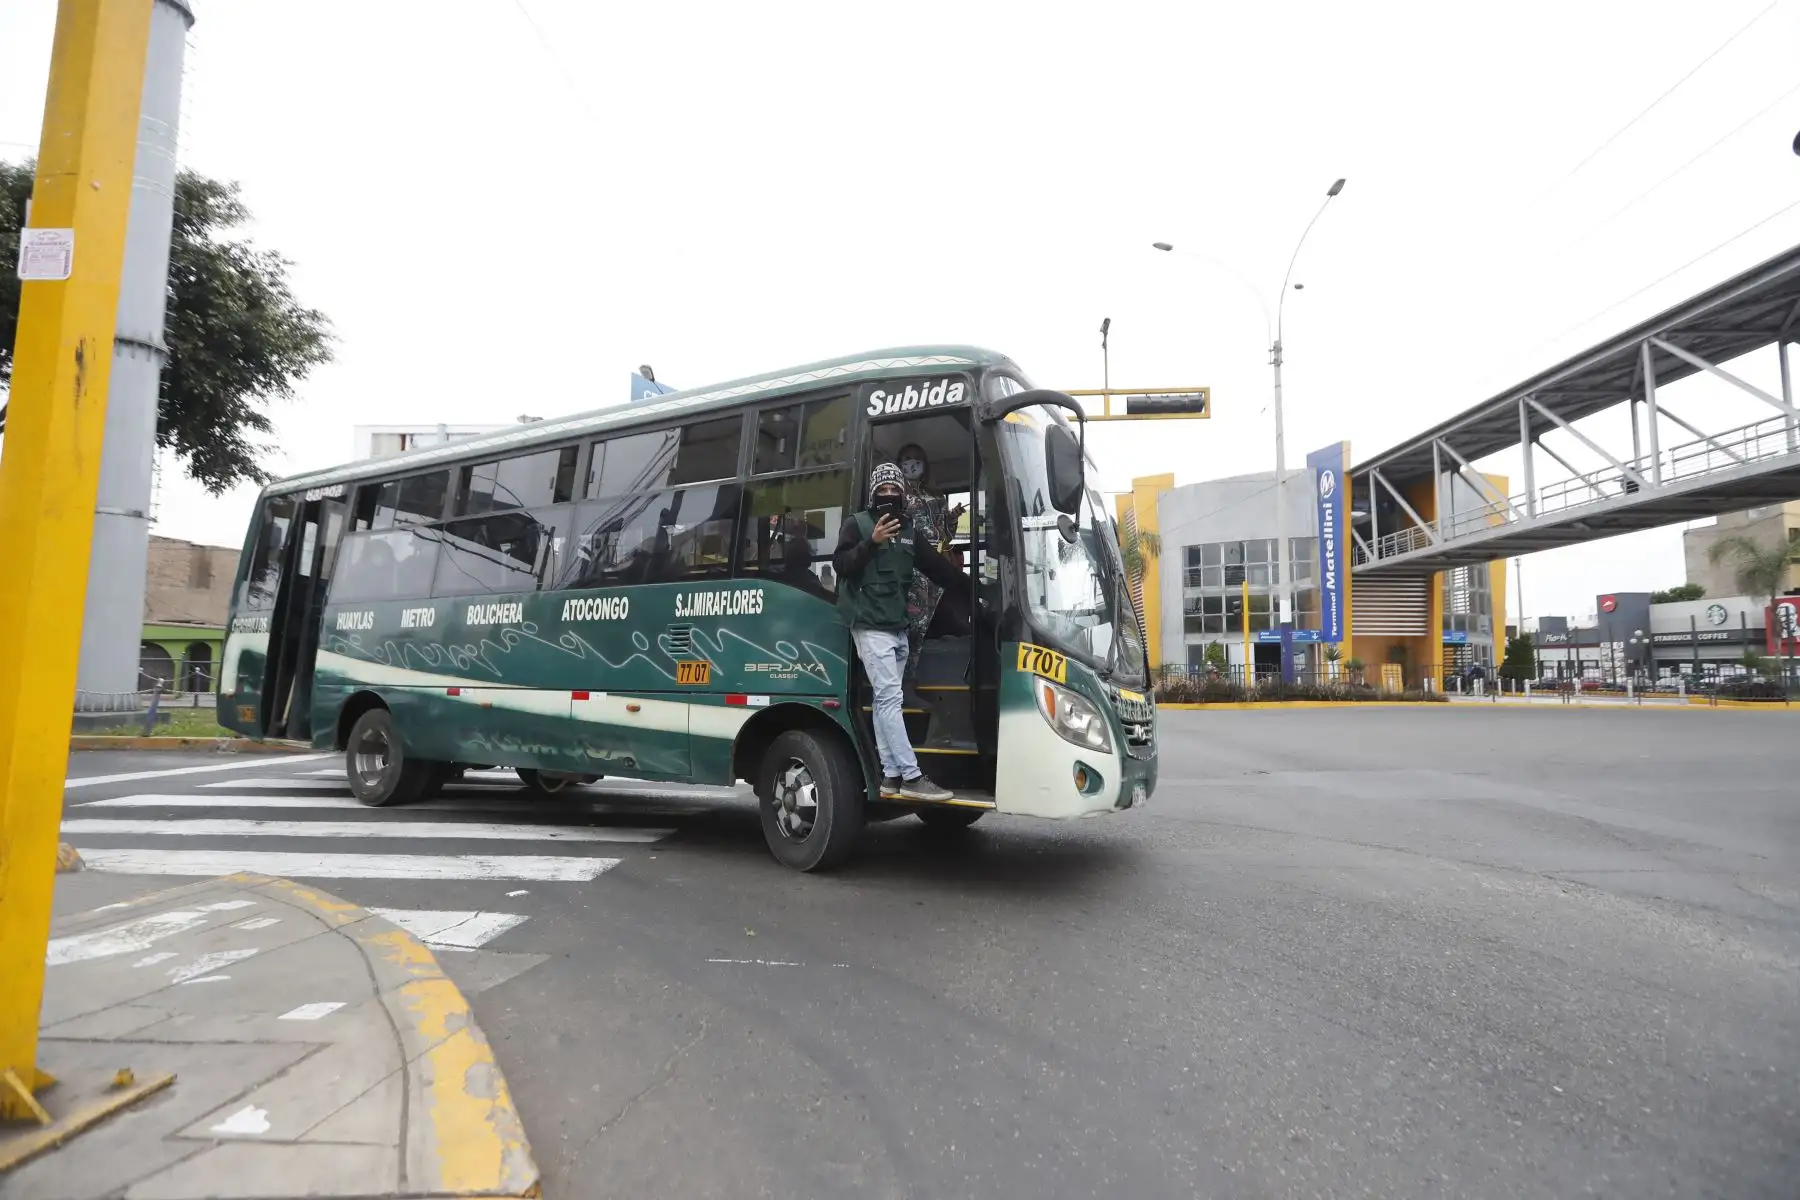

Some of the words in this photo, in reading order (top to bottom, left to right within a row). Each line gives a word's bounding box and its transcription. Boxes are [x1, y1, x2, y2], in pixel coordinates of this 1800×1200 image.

[867, 379, 966, 416] Subida
[1323, 503, 1336, 589] Matellini
[466, 603, 523, 625] BOLICHERA
[561, 597, 629, 621] ATOCONGO
[675, 589, 764, 617] S.J.MIRAFLORES
[336, 612, 374, 630] HUAYLAS
[401, 608, 435, 628] METRO
[1653, 634, 1692, 642] STARBUCK
[744, 664, 826, 672] BERJAYA
[1021, 645, 1065, 678] 7707
